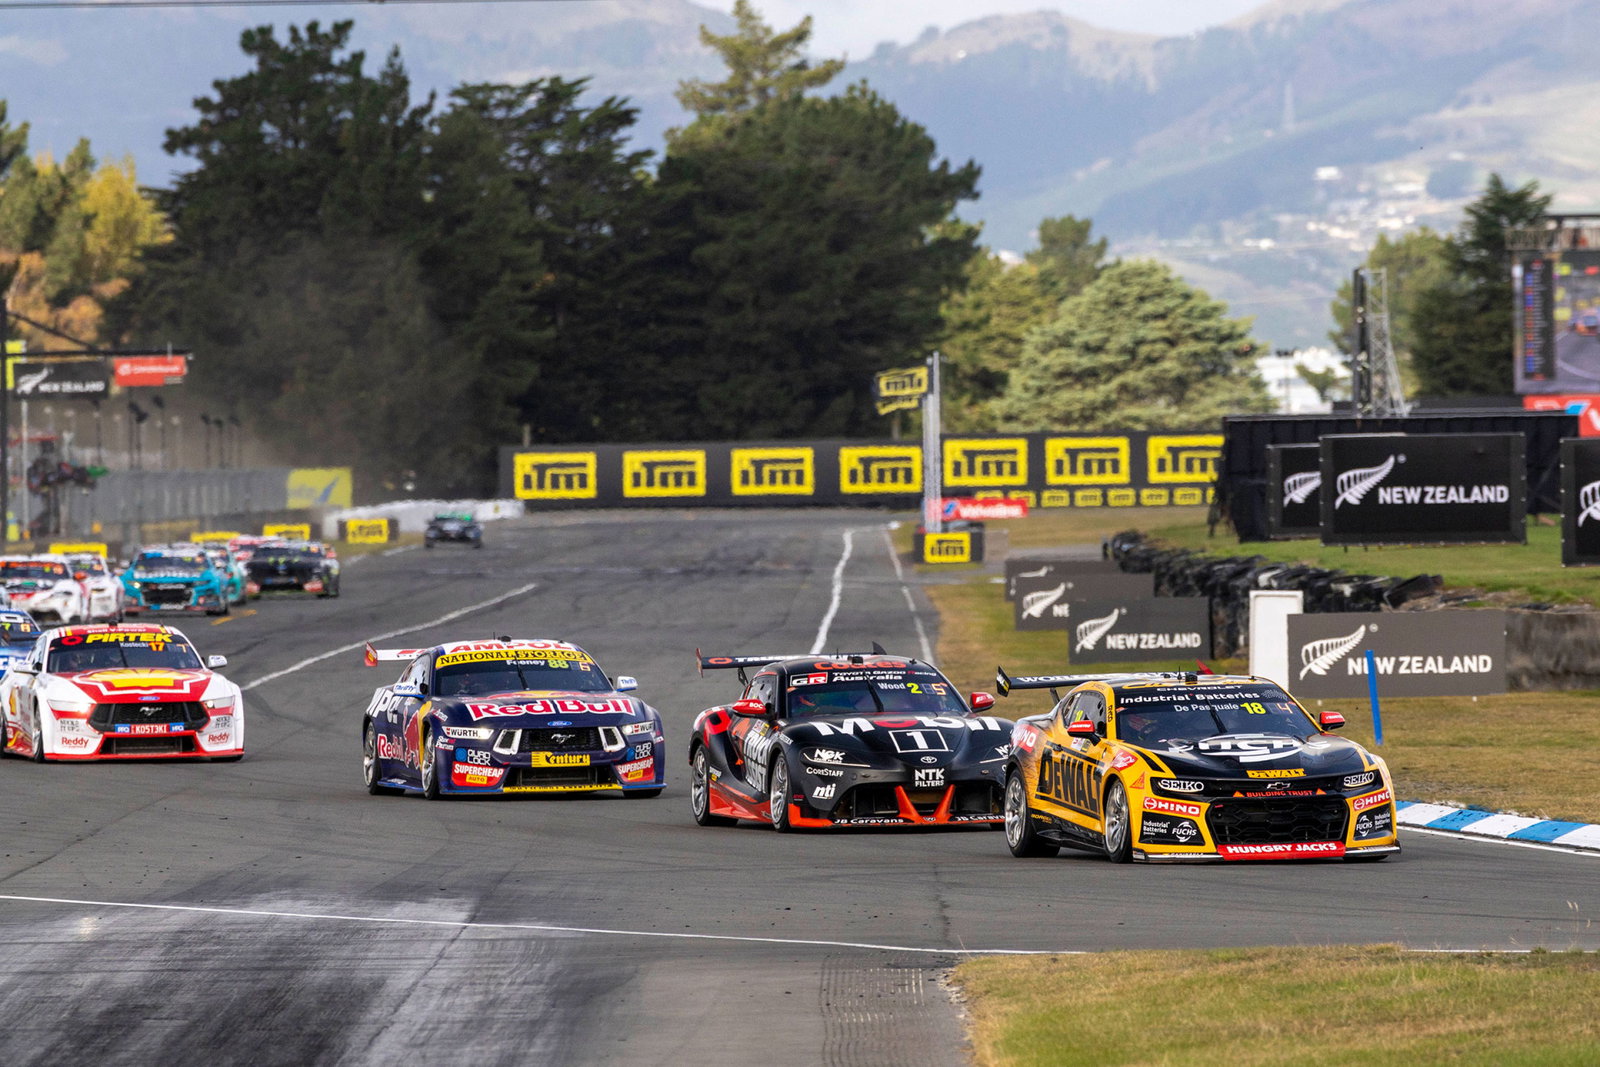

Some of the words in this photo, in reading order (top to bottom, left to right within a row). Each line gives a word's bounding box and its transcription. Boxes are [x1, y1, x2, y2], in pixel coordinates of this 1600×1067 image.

[1377, 486, 1422, 504] NEW
[1423, 484, 1510, 504] ZEALAND
[1052, 603, 1070, 618] NE
[86, 632, 173, 645] PIRTEK
[1106, 633, 1138, 650] NEW
[1140, 632, 1202, 649] ZEALAND
[148, 641, 166, 652] 17
[440, 651, 514, 665] NATIONAL
[515, 649, 587, 661] STORAGE
[506, 659, 546, 667] Feeney
[548, 659, 569, 668] 88
[814, 661, 907, 671] Coates
[1398, 655, 1492, 674] ZEALAND
[791, 674, 827, 686] GR
[832, 673, 903, 683] Australia
[877, 682, 906, 690] Wood
[906, 682, 923, 695] 2
[931, 683, 947, 696] 5
[1120, 692, 1191, 704] Industrial
[1196, 691, 1260, 701] Batteries
[465, 700, 554, 721] Red
[554, 699, 636, 717] Bull
[1173, 704, 1190, 713] De
[1191, 702, 1240, 712] Pasquale
[1240, 702, 1267, 715] 18
[1277, 702, 1294, 714] 4
[809, 716, 1002, 737] Mobil
[62, 736, 90, 749] Reddy
[906, 731, 929, 749] 1
[467, 749, 491, 759] QUAD
[814, 748, 846, 761] NGK
[467, 756, 492, 767] LOCK
[617, 757, 654, 775] SUPERCHEAP
[453, 763, 505, 778] SUPERCHEAP
[914, 768, 945, 781] NTK
[915, 779, 945, 788] FILTERS
[1343, 771, 1375, 786] SEIKO
[1160, 779, 1205, 792] SEIKO
[1158, 801, 1200, 815] HINO
[1143, 820, 1169, 829] Industrial
[1143, 826, 1168, 834] Batteries
[1356, 821, 1373, 831] FUCHS
[1171, 827, 1198, 837] FUCHS
[1225, 844, 1294, 855] HUNGRY
[1294, 842, 1337, 852] JACK'S
